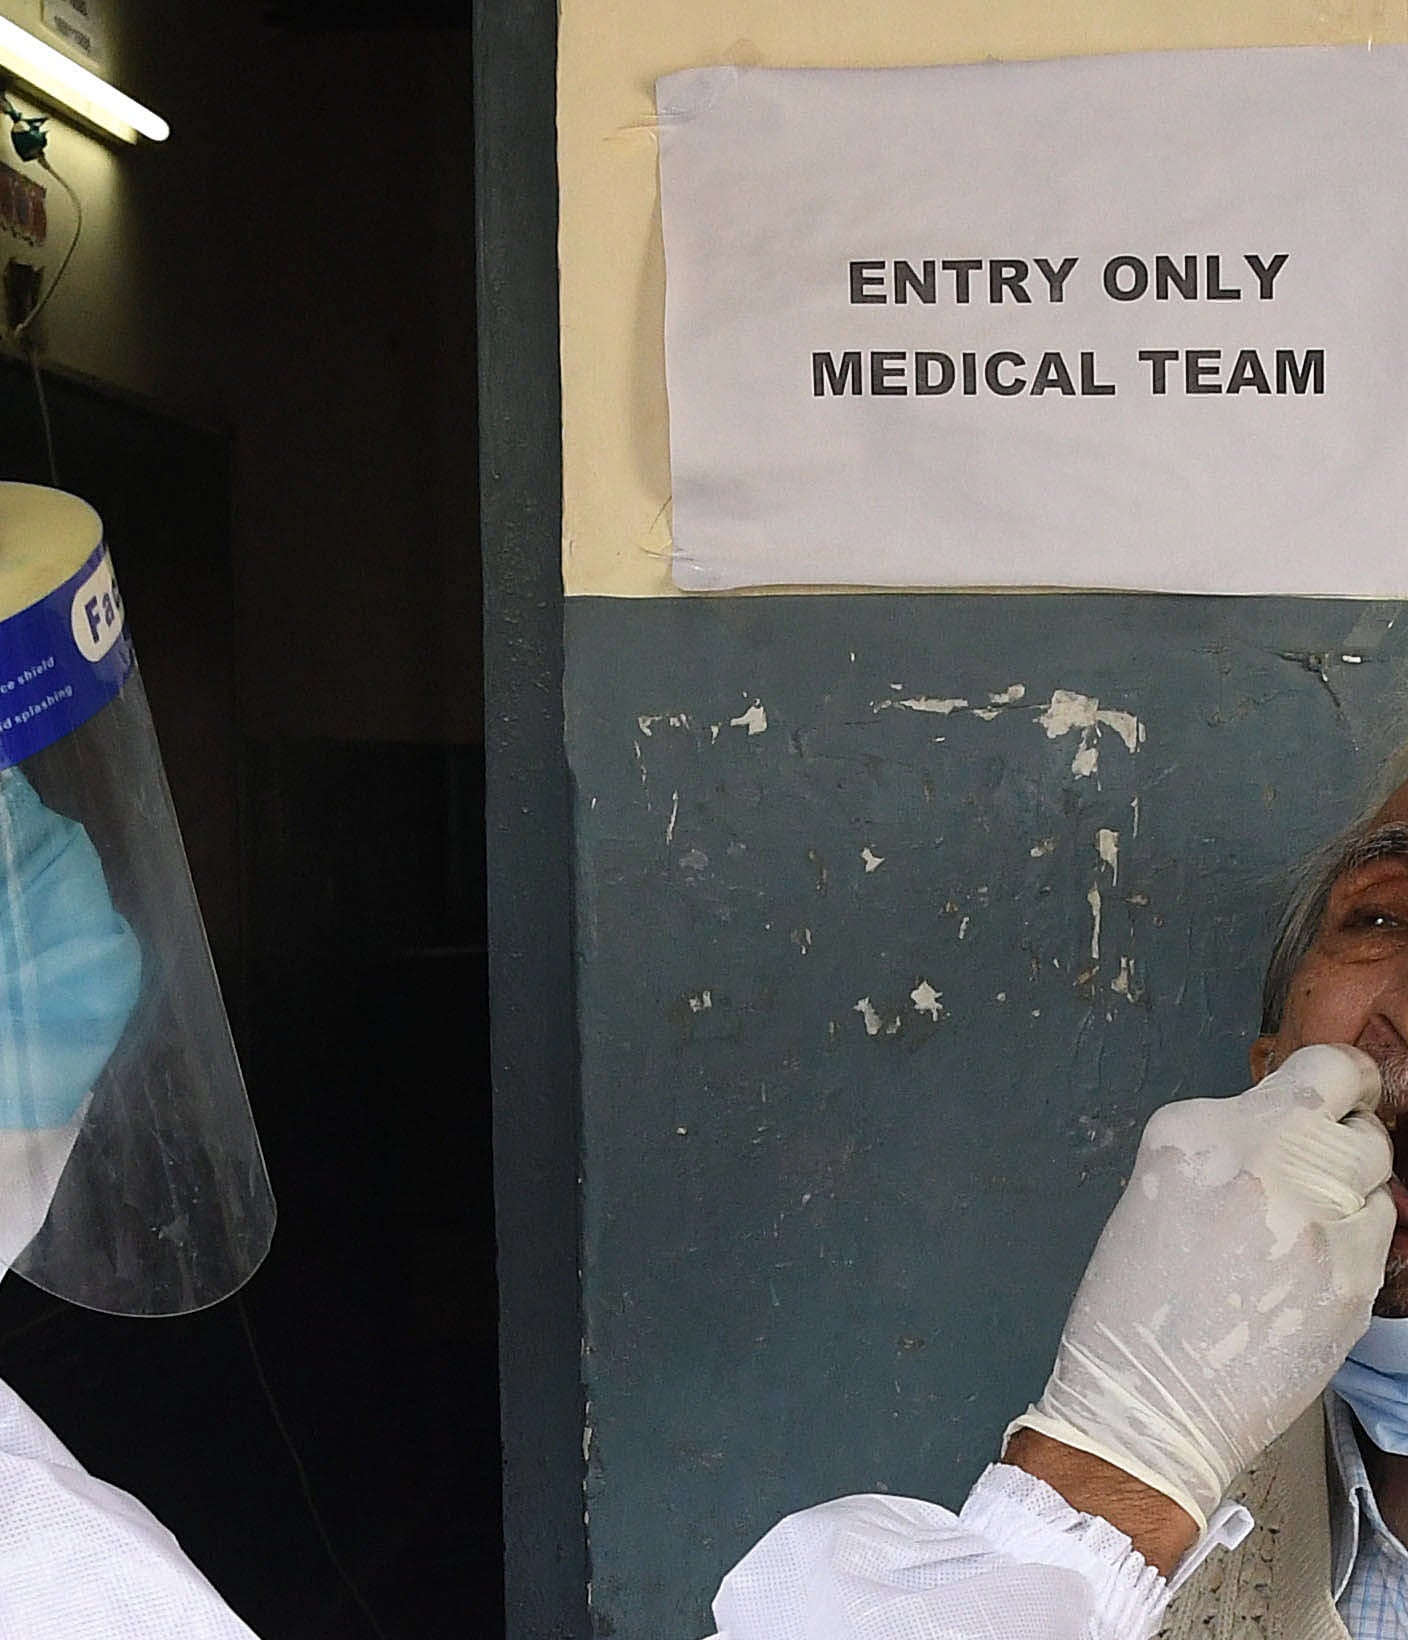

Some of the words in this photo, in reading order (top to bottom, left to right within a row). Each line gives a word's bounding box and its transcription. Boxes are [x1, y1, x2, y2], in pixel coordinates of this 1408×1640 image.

[848, 255, 1078, 304] ENTRY
[1103, 253, 1290, 302] ONLY
[811, 350, 1116, 397] MEDICAL
[1138, 348, 1326, 395] TEAM
[17, 656, 55, 686] shield
[14, 684, 73, 725] splashing
